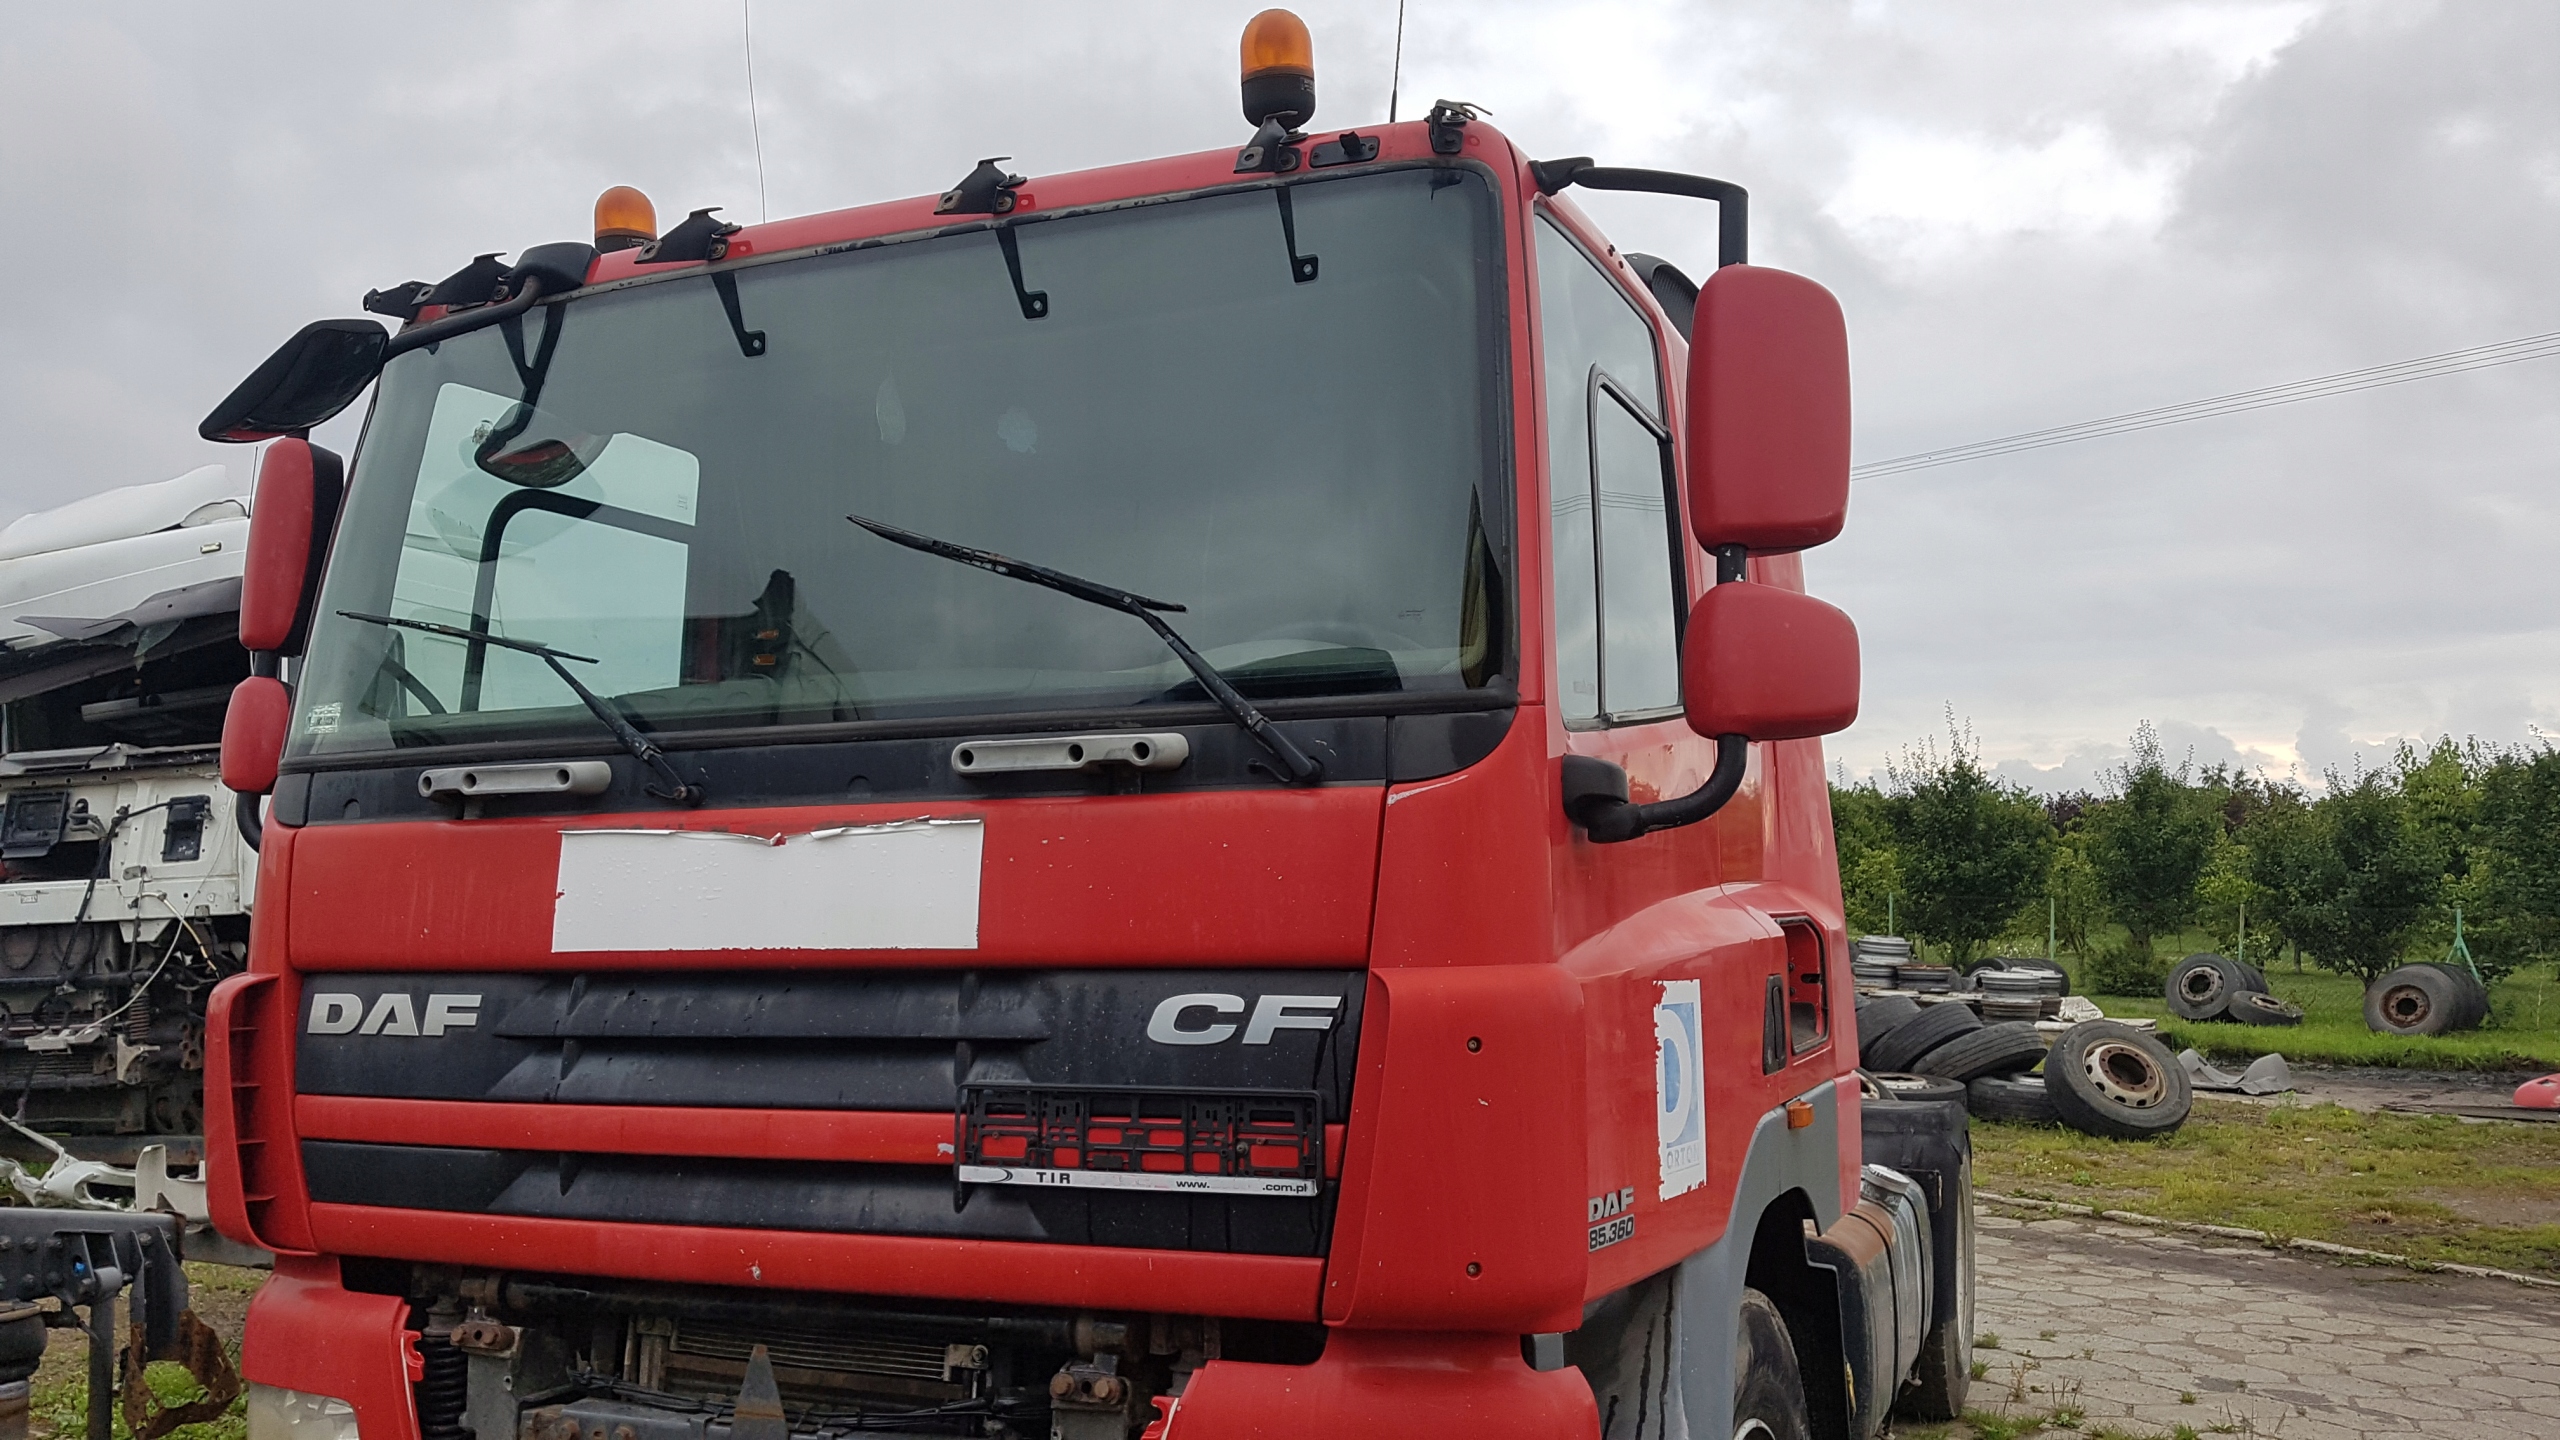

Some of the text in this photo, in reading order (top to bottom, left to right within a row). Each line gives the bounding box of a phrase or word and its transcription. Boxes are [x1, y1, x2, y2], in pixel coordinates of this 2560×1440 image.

[307, 993, 482, 1036] DAF
[1147, 993, 1342, 1045] CF
[1036, 1172, 1071, 1185] TIR
[1588, 1186, 1634, 1222] DAF
[1589, 1216, 1634, 1250] 85.360
